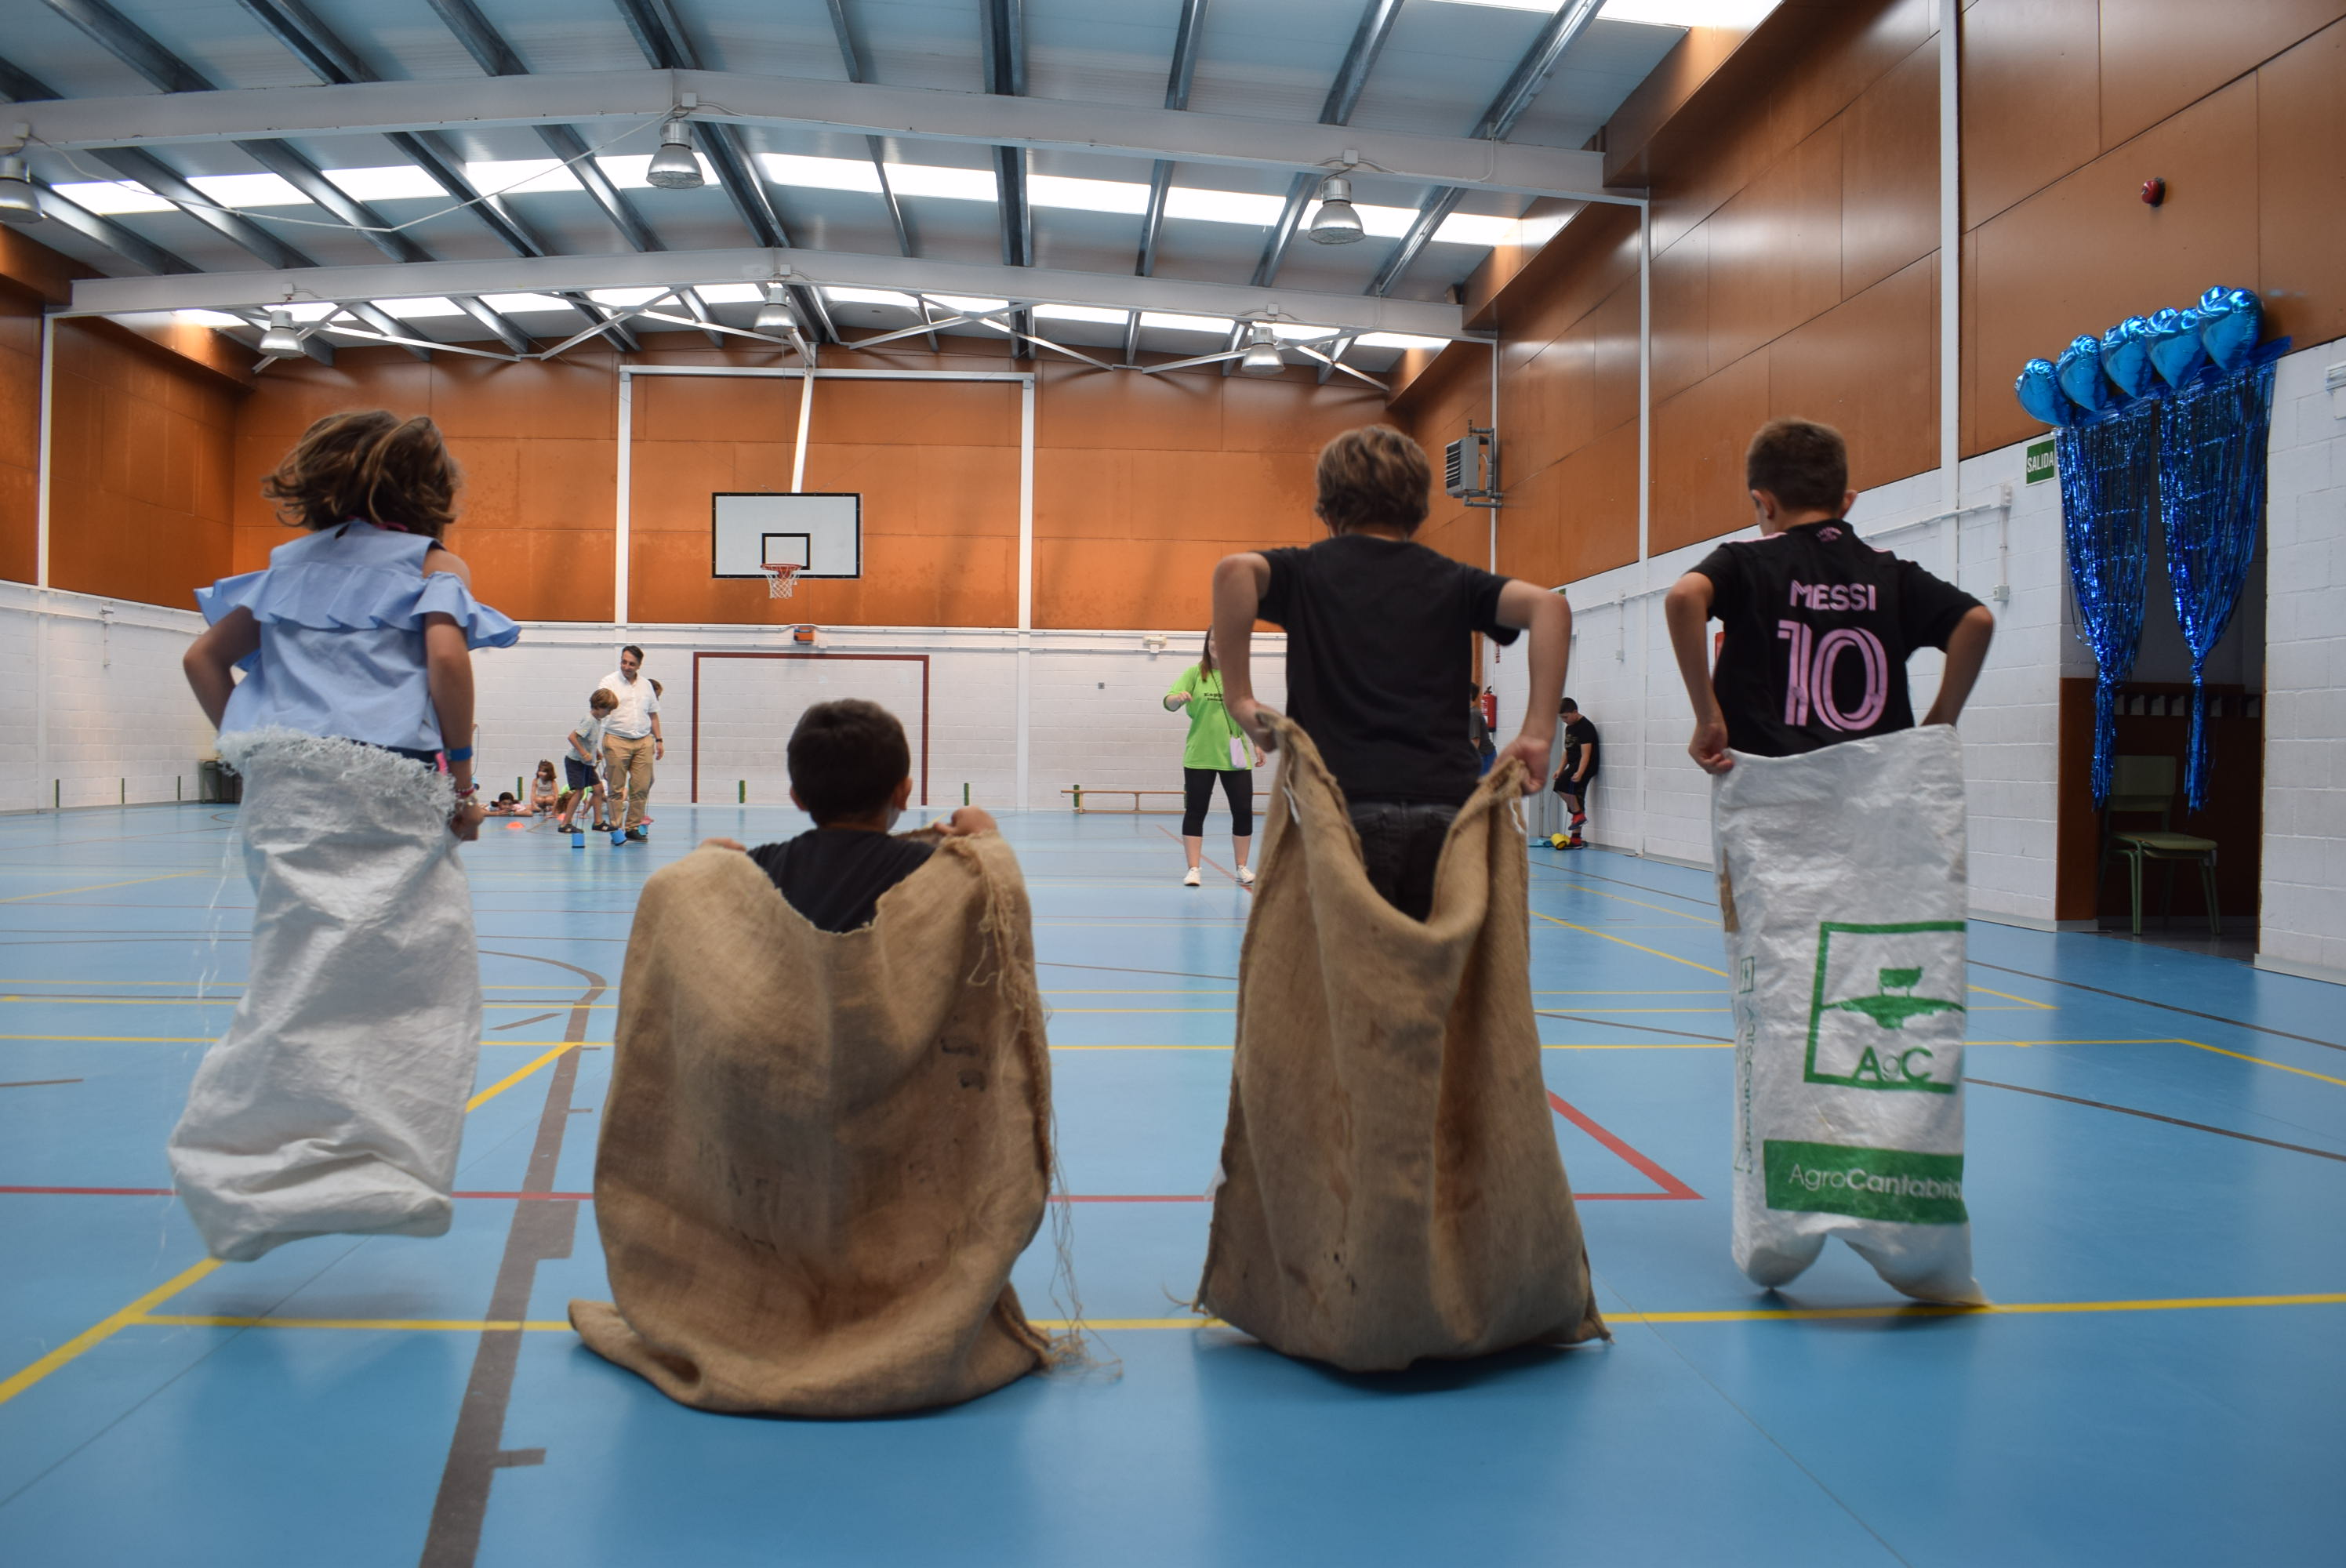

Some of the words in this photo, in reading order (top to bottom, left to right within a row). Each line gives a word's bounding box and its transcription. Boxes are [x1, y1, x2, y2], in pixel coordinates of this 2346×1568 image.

[2027, 451, 2054, 473] SALIDA
[1789, 579, 1876, 612] MESSI
[1778, 619, 1888, 732] 10
